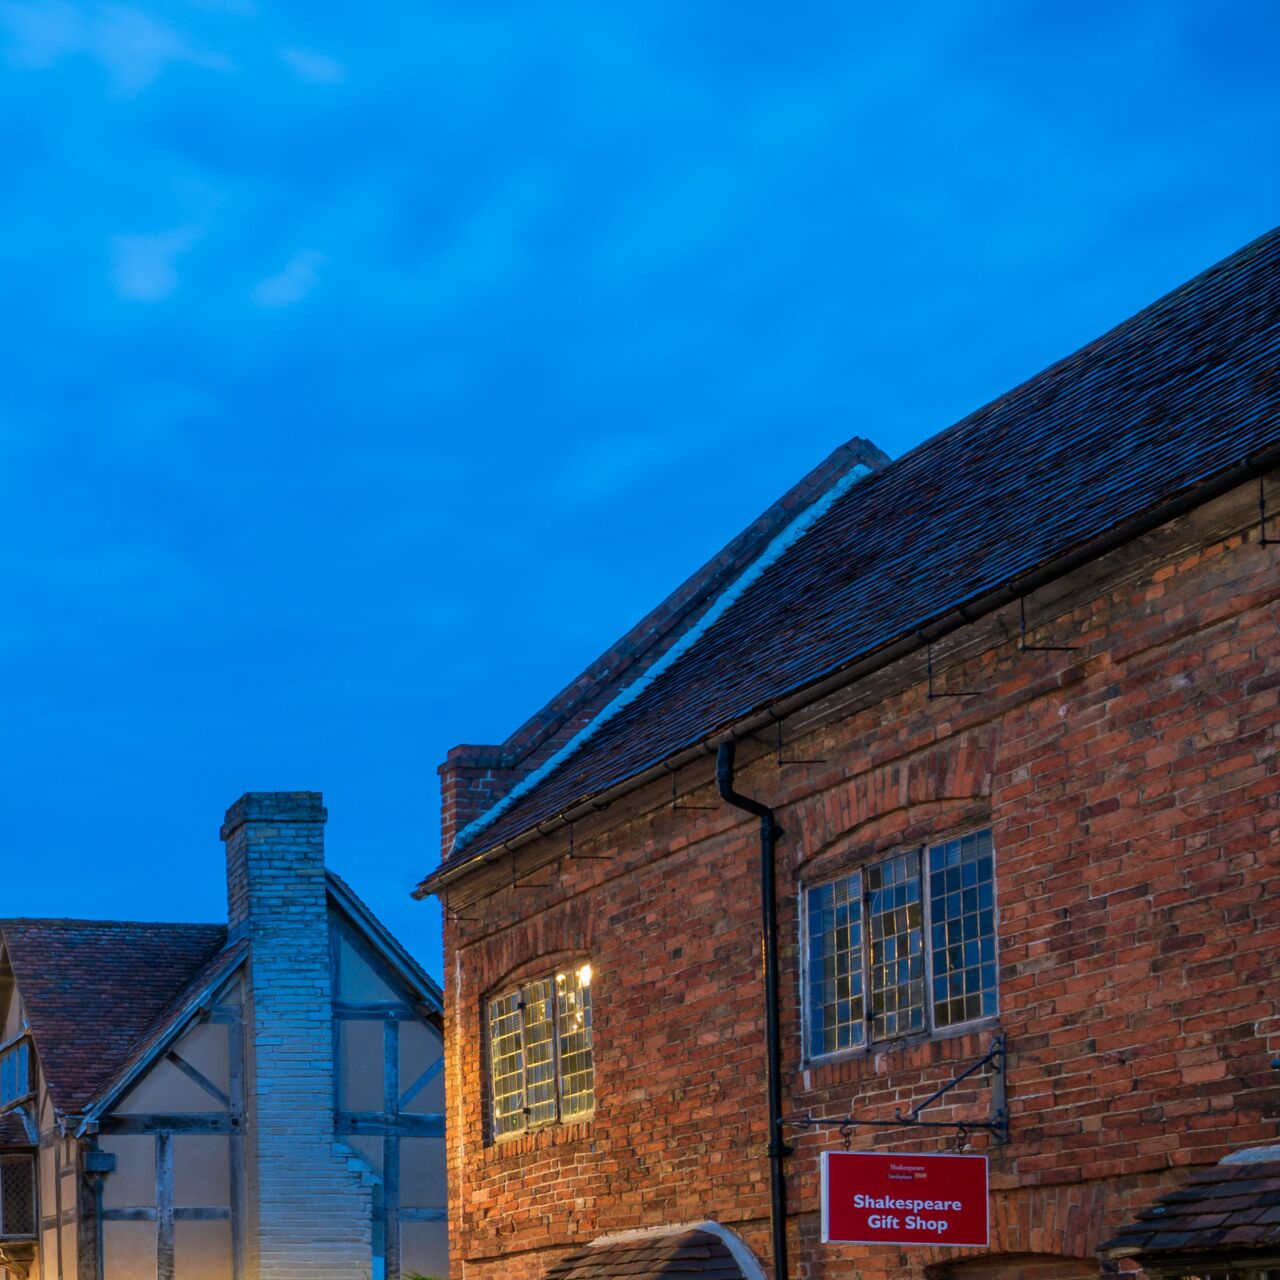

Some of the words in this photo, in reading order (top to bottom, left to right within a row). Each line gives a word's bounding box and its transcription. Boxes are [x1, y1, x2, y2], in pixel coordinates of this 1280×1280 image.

[853, 1194, 962, 1213] Shakespeare
[867, 1215, 900, 1229] Gift
[905, 1215, 948, 1234] Shop
